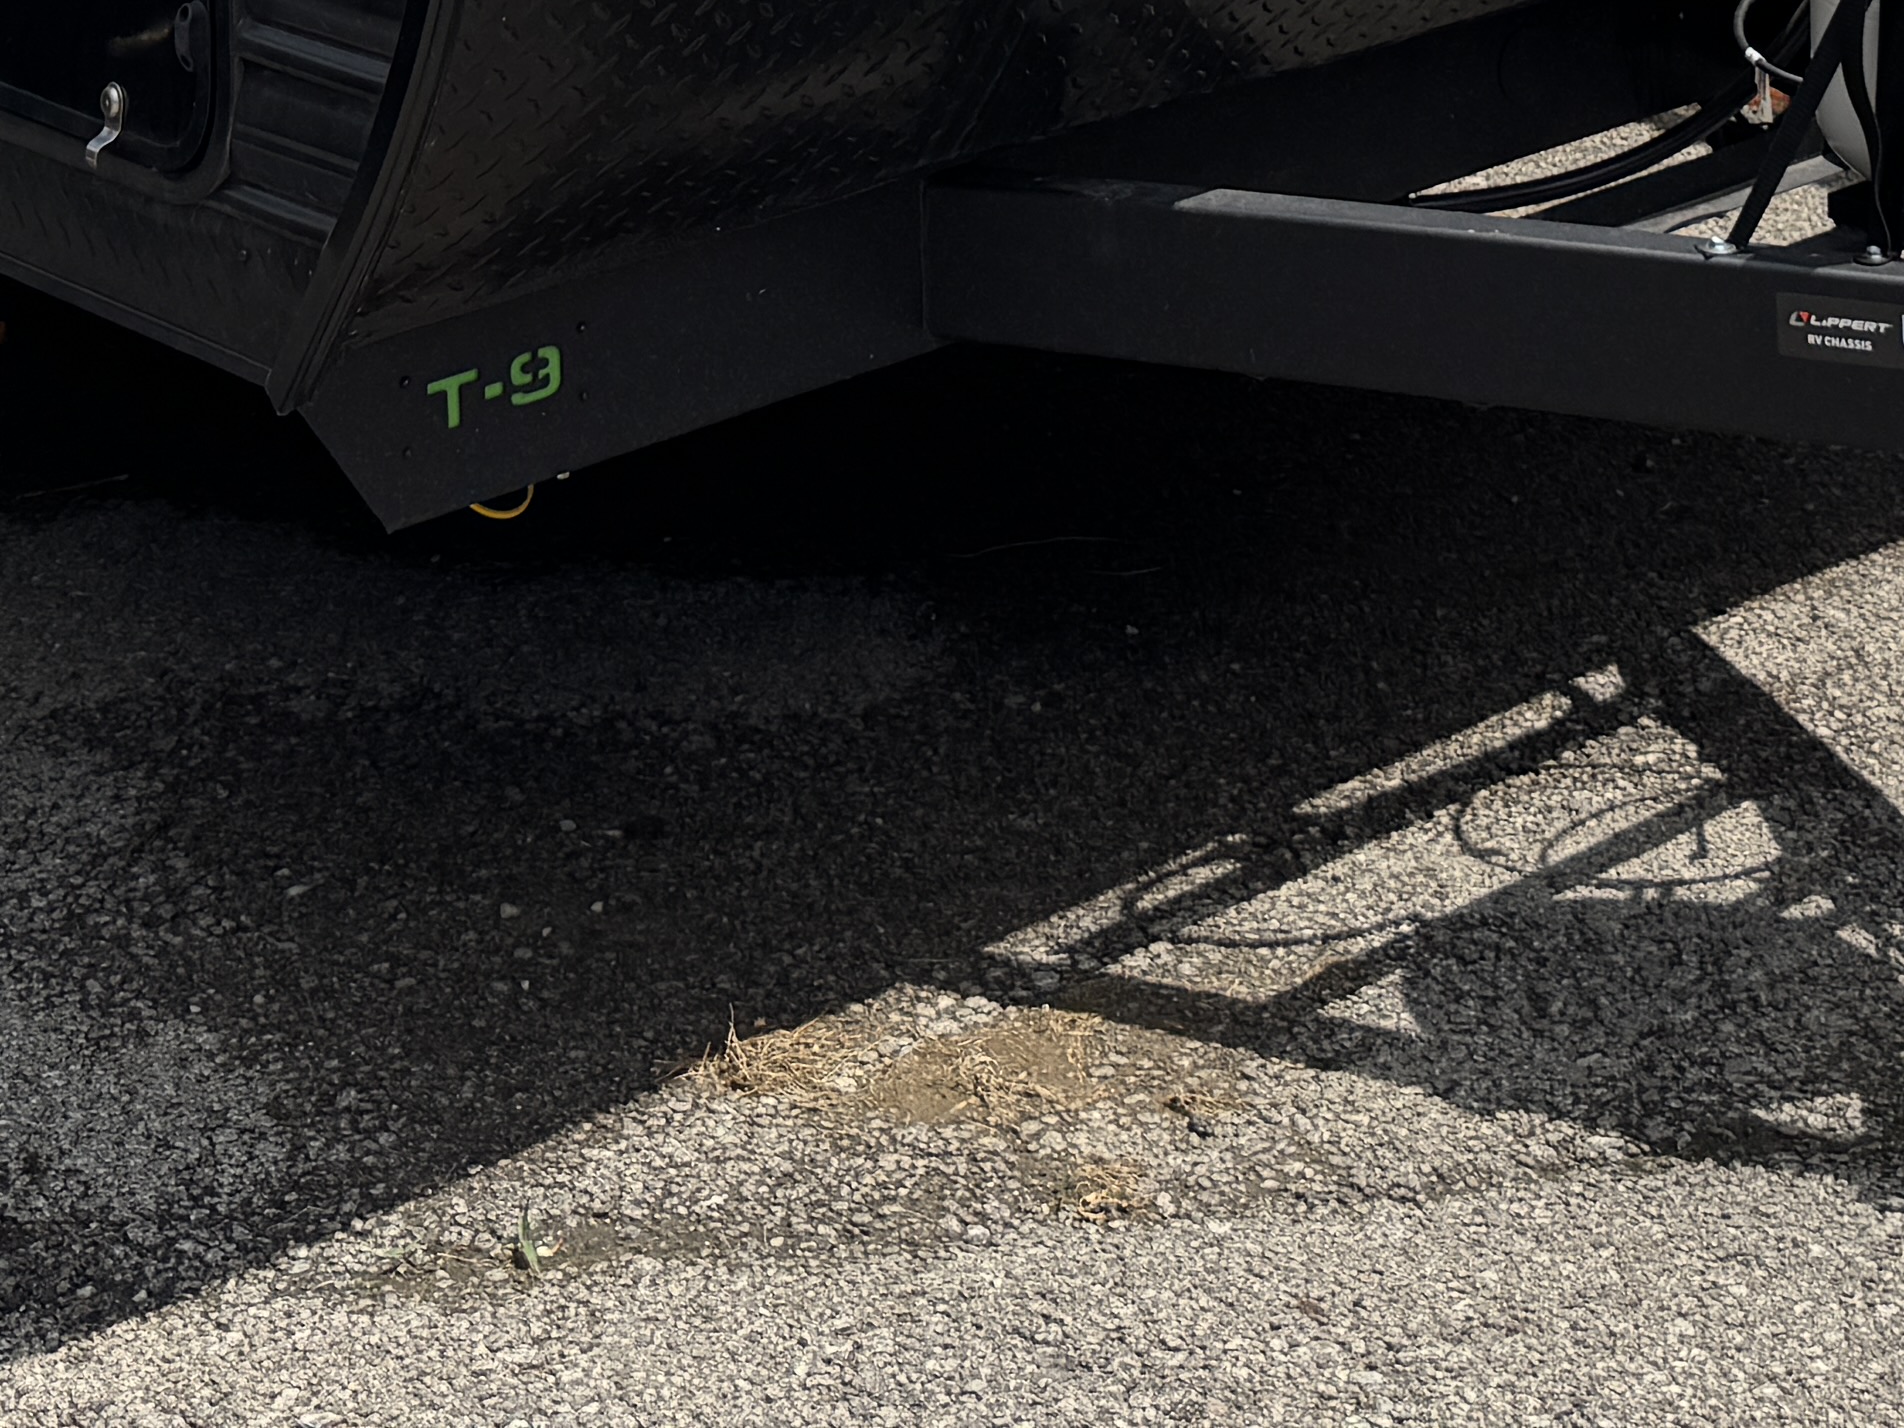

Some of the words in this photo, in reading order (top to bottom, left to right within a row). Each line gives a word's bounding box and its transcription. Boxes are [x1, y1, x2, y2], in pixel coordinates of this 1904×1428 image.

[1810, 314, 1894, 334] LIPPERT
[1807, 334, 1822, 345] RV
[1824, 336, 1873, 352] CHASSIS
[427, 345, 562, 428] T-9
